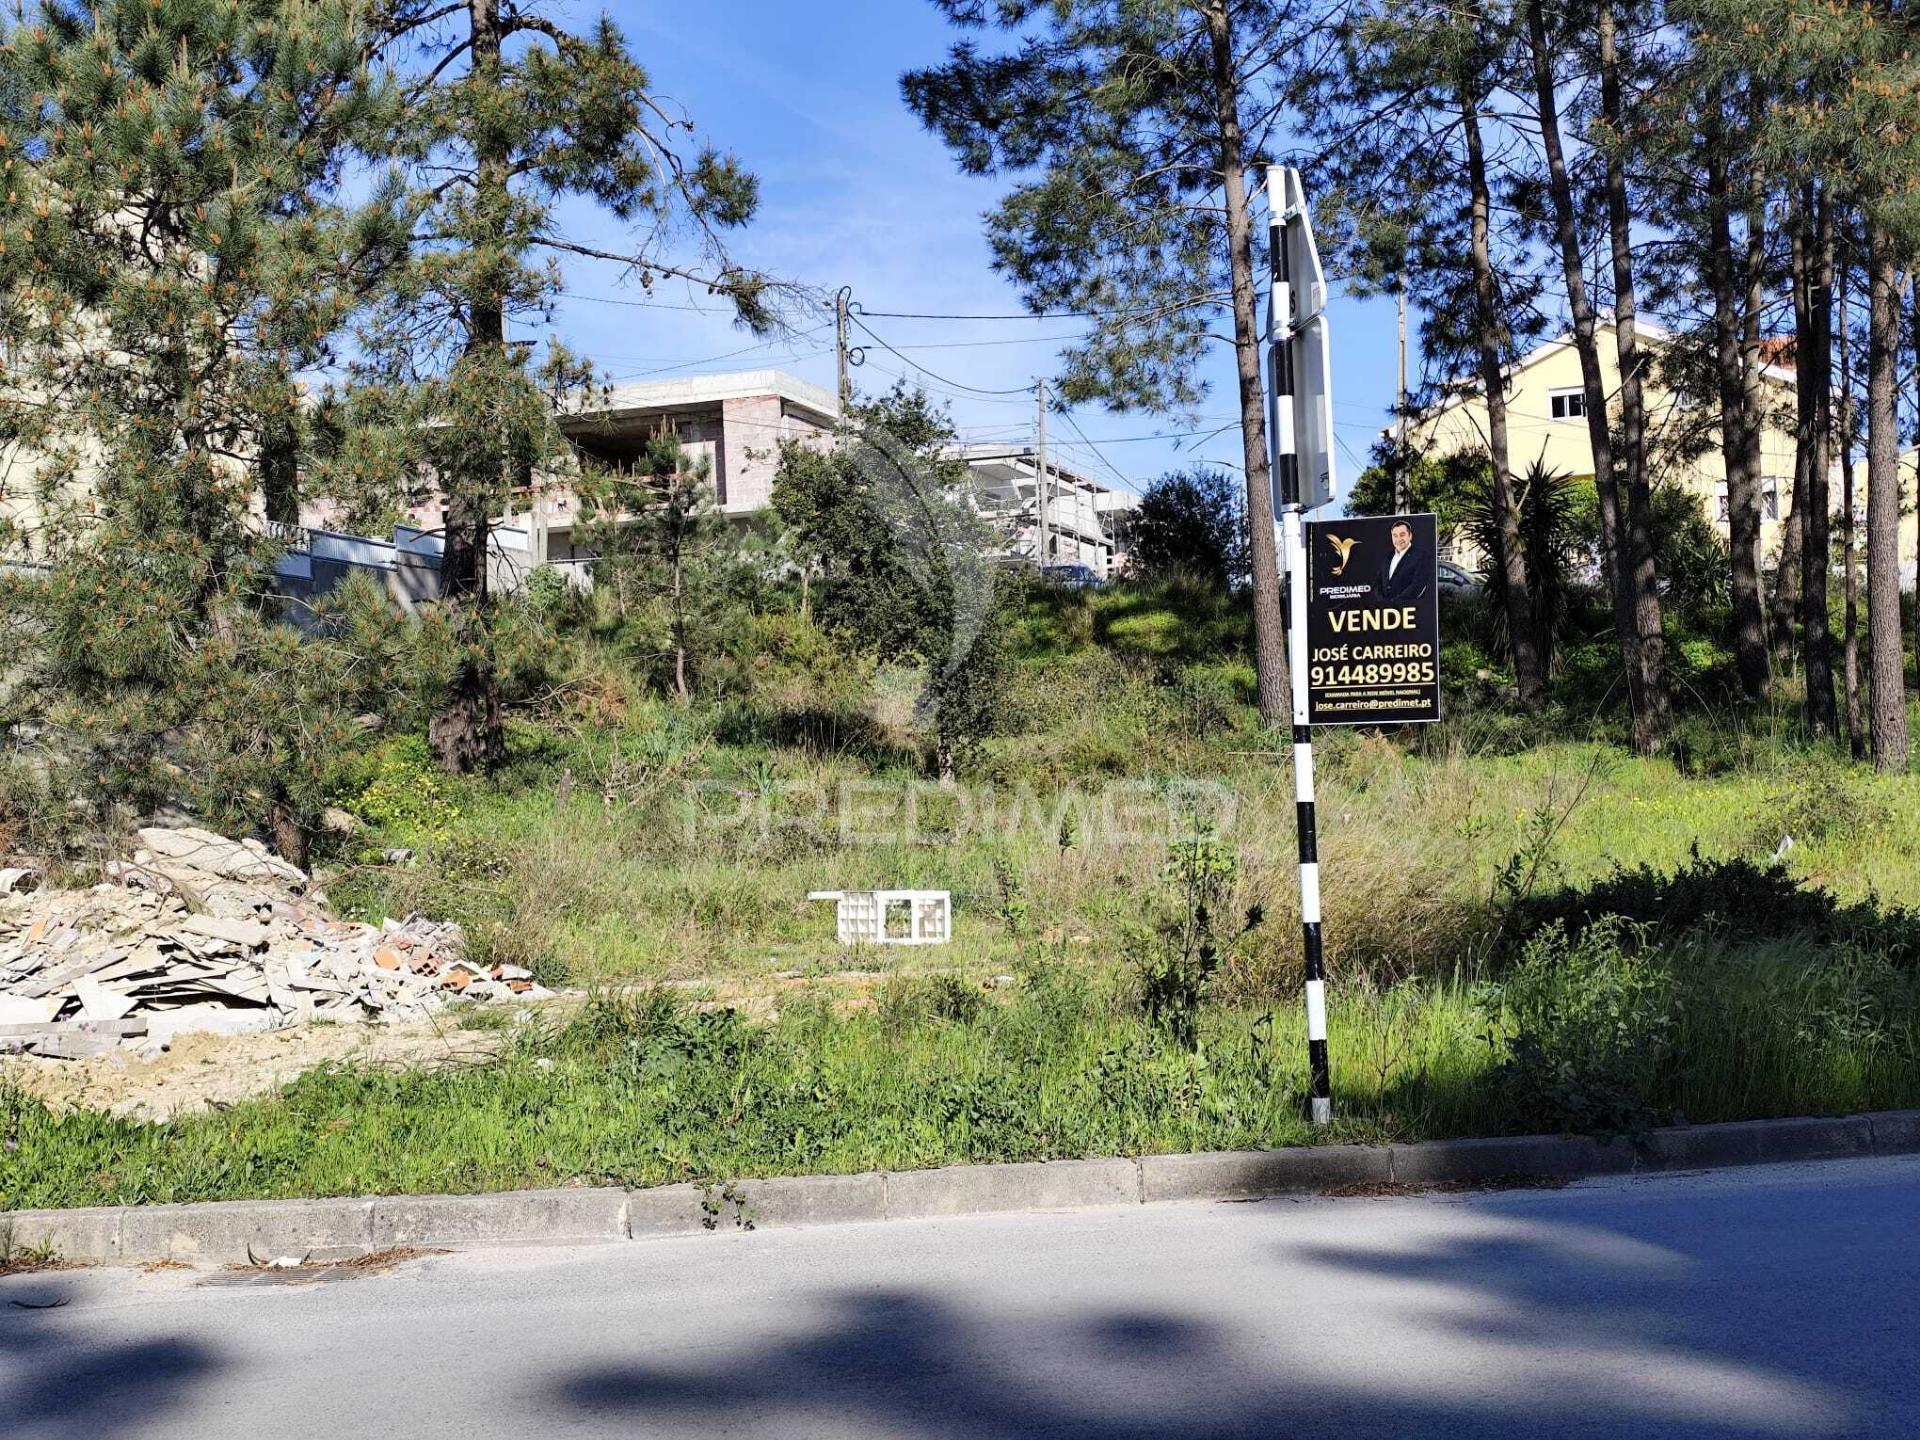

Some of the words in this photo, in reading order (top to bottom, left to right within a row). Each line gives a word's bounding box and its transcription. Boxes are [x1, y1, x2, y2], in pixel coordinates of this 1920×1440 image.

[1319, 584, 1371, 595] PREDIMED
[1328, 607, 1417, 633] VENDE
[1312, 644, 1349, 662] JOSÉ
[1352, 643, 1432, 660] CARREIRO
[1310, 662, 1435, 686] 914489985
